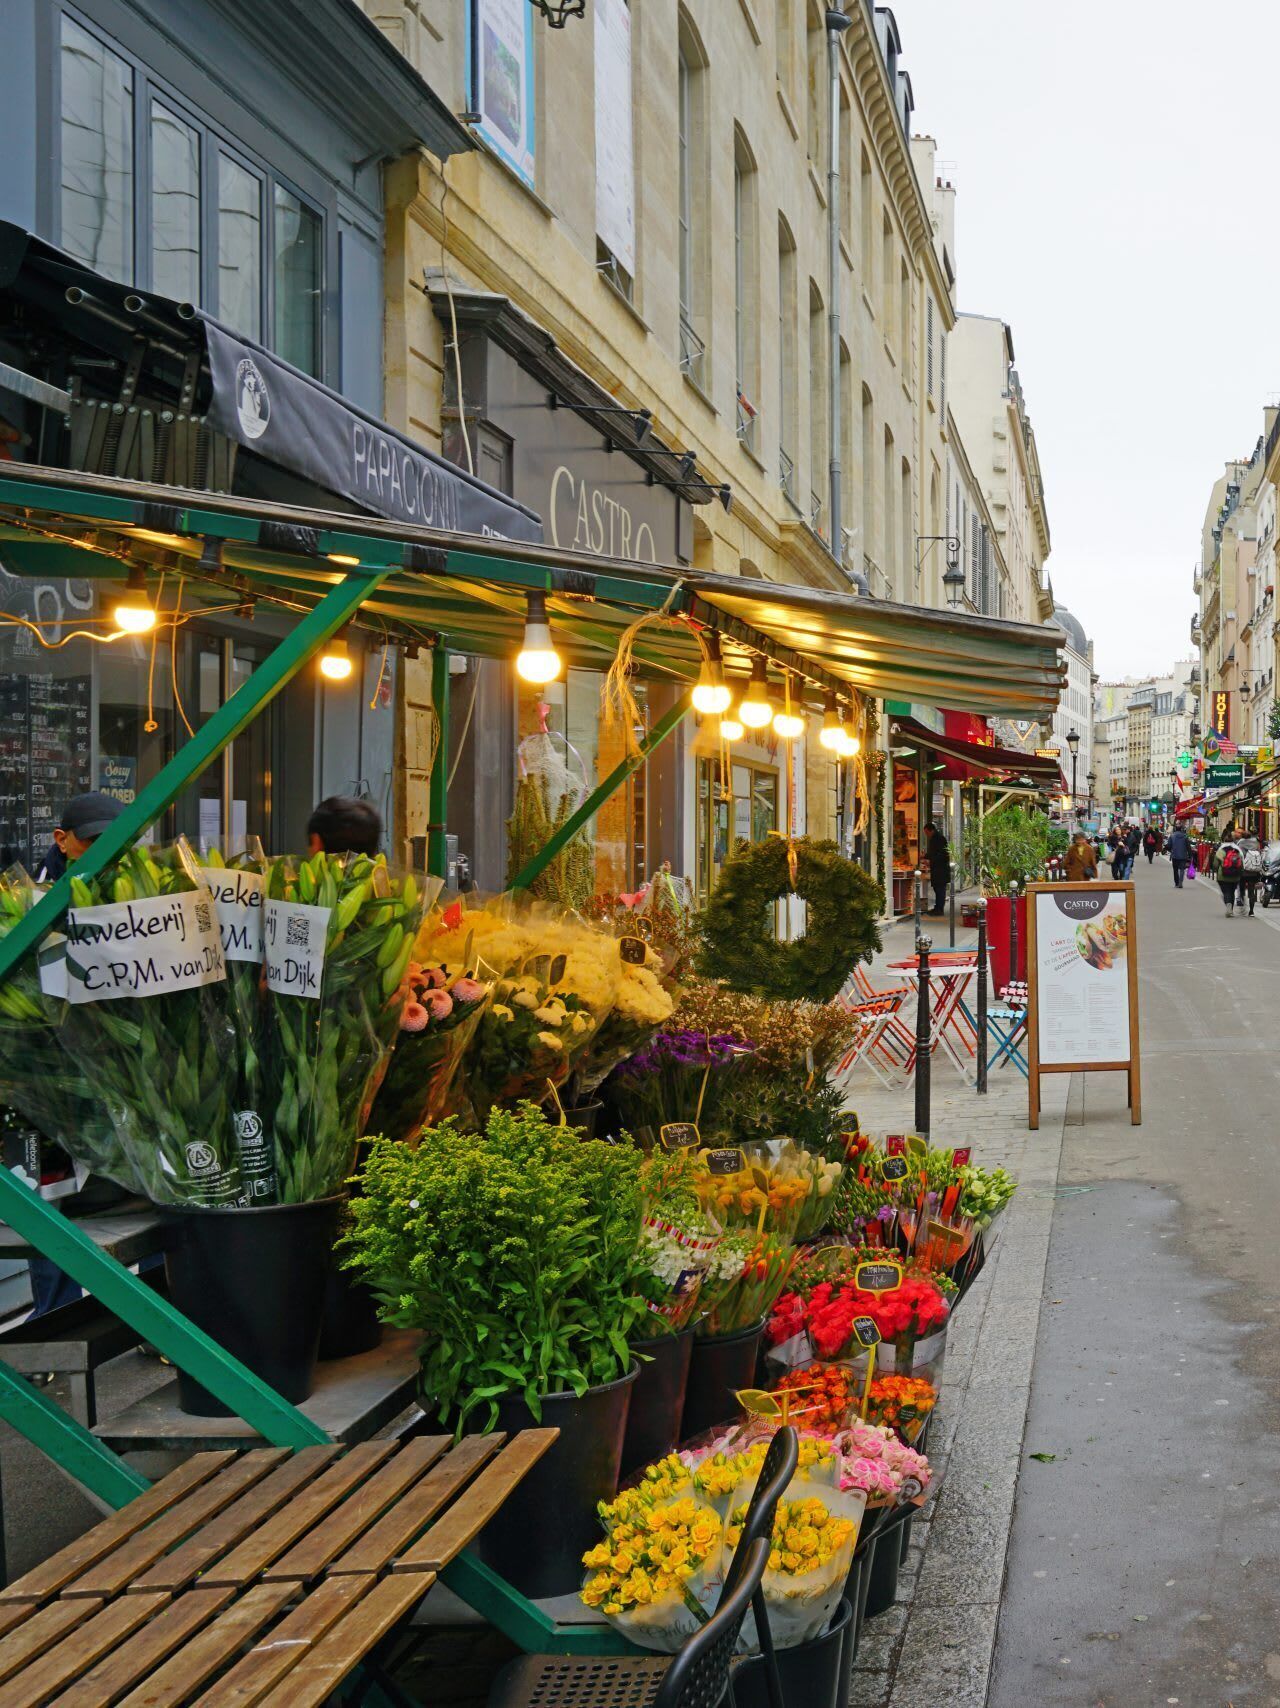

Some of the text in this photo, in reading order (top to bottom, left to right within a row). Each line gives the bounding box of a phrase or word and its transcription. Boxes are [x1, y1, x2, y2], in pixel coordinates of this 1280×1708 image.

[550, 466, 656, 562] CASTRO
[1216, 693, 1227, 734] HOTE
[105, 759, 131, 783] Sorry
[1063, 900, 1099, 910] CASTRO
[83, 957, 165, 991] C.P.M.
[284, 958, 316, 995] Dijk
[28, 1134, 37, 1171] Helleborus
